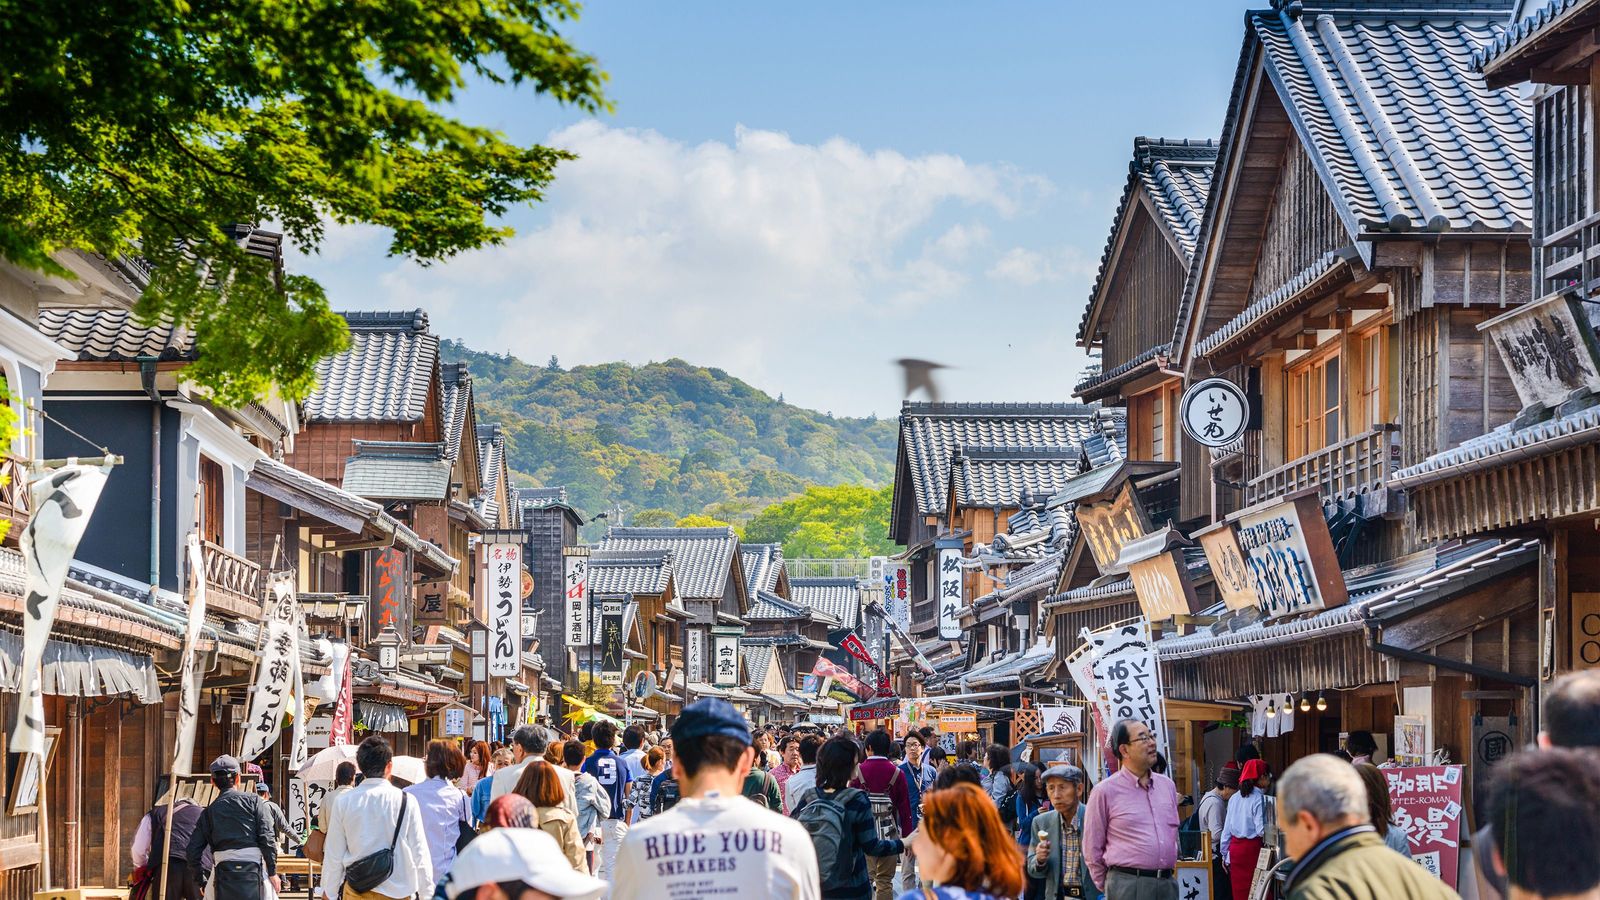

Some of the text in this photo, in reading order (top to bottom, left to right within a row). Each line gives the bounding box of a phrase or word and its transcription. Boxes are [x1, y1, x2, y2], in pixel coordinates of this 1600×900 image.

[942, 555, 961, 620] 松阪牛
[495, 562, 514, 660] 伊勢うどん
[571, 601, 582, 643] 岡七酒店
[598, 758, 617, 784] 3
[1391, 796, 1451, 805] FFEE-ROMAN
[644, 829, 783, 860] RIDE YOUR
[656, 857, 736, 876] SNEAKERS
